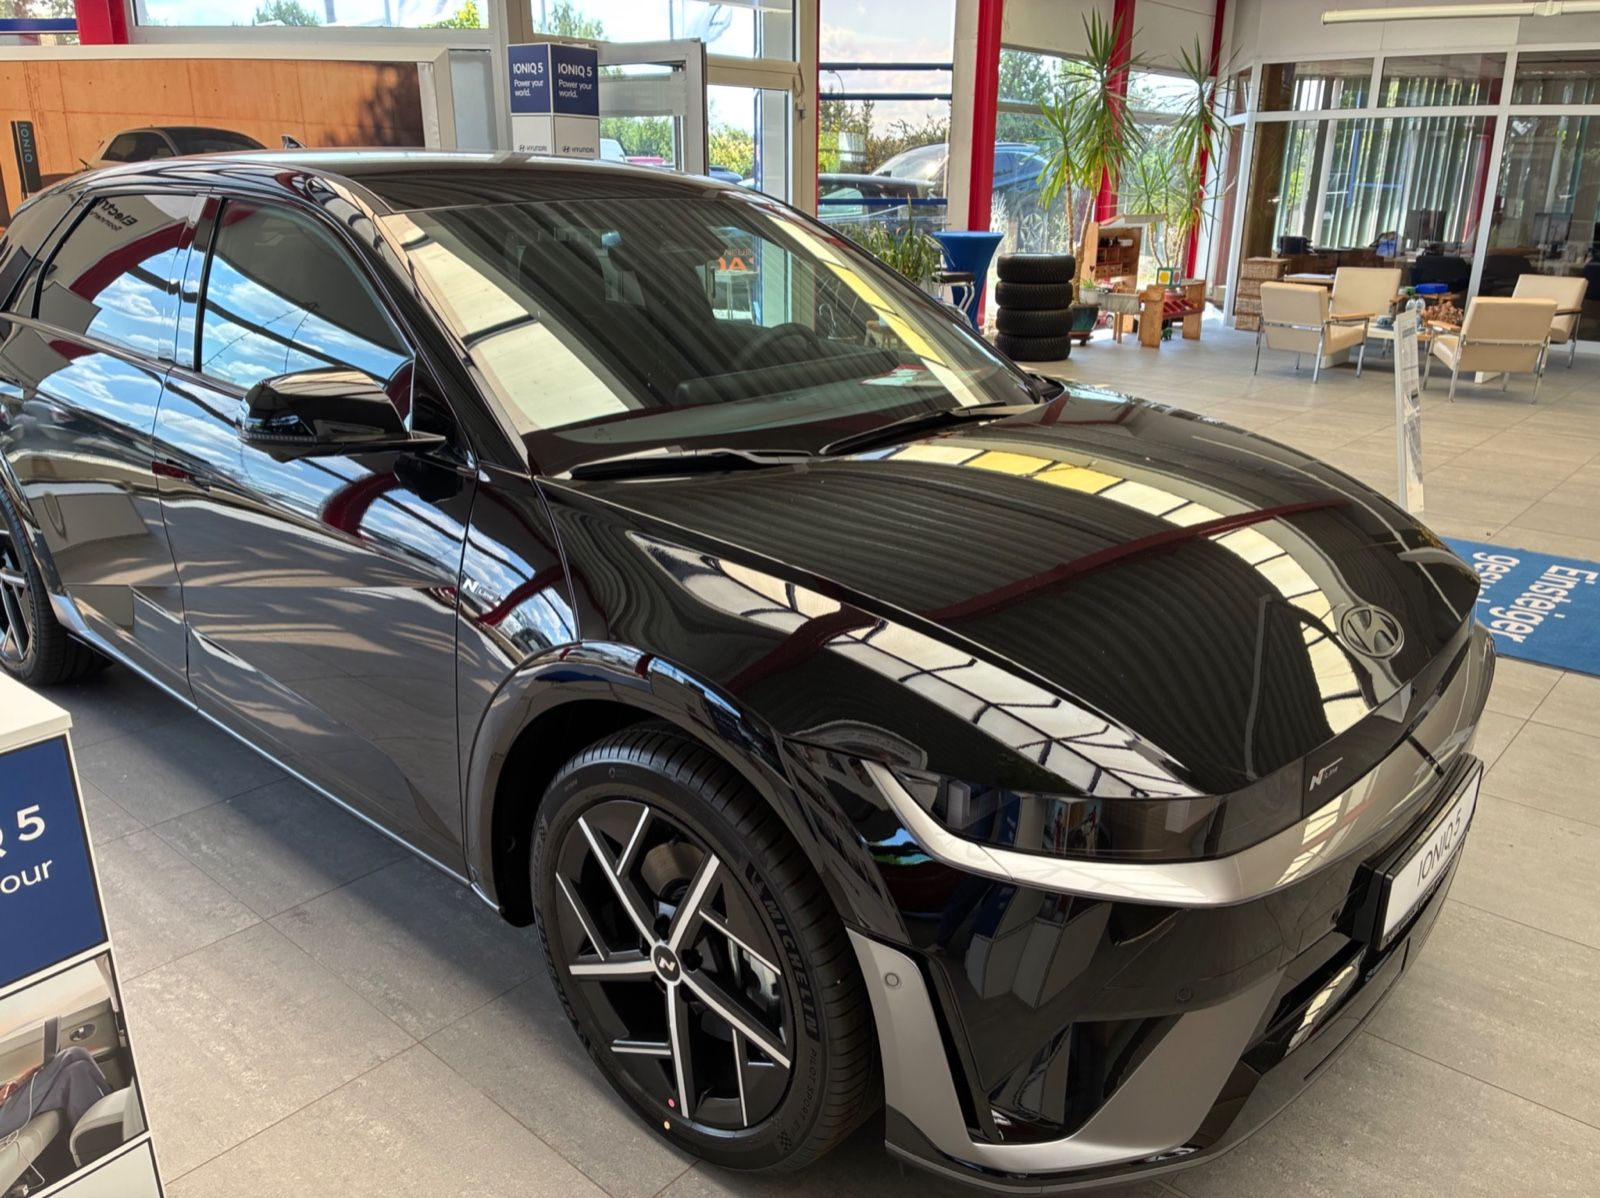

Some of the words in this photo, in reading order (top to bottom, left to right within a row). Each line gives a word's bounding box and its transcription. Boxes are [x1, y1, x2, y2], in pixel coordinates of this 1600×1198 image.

[513, 62, 537, 75] IONIQ
[538, 62, 544, 74] 5
[558, 63, 585, 78] IONIQ
[586, 66, 593, 77] 5
[514, 79, 530, 87] Power
[532, 80, 544, 88] your
[558, 79, 578, 89] Power
[579, 83, 592, 91] your
[20, 123, 33, 163] IONIQ
[462, 578, 479, 593] N
[1488, 564, 1599, 644] Einsteiger
[17, 804, 46, 841] 5
[1417, 820, 1455, 887] IONIQ
[1453, 807, 1462, 837] 5
[659, 956, 676, 972] N
[763, 899, 820, 1041] MICHELIN
